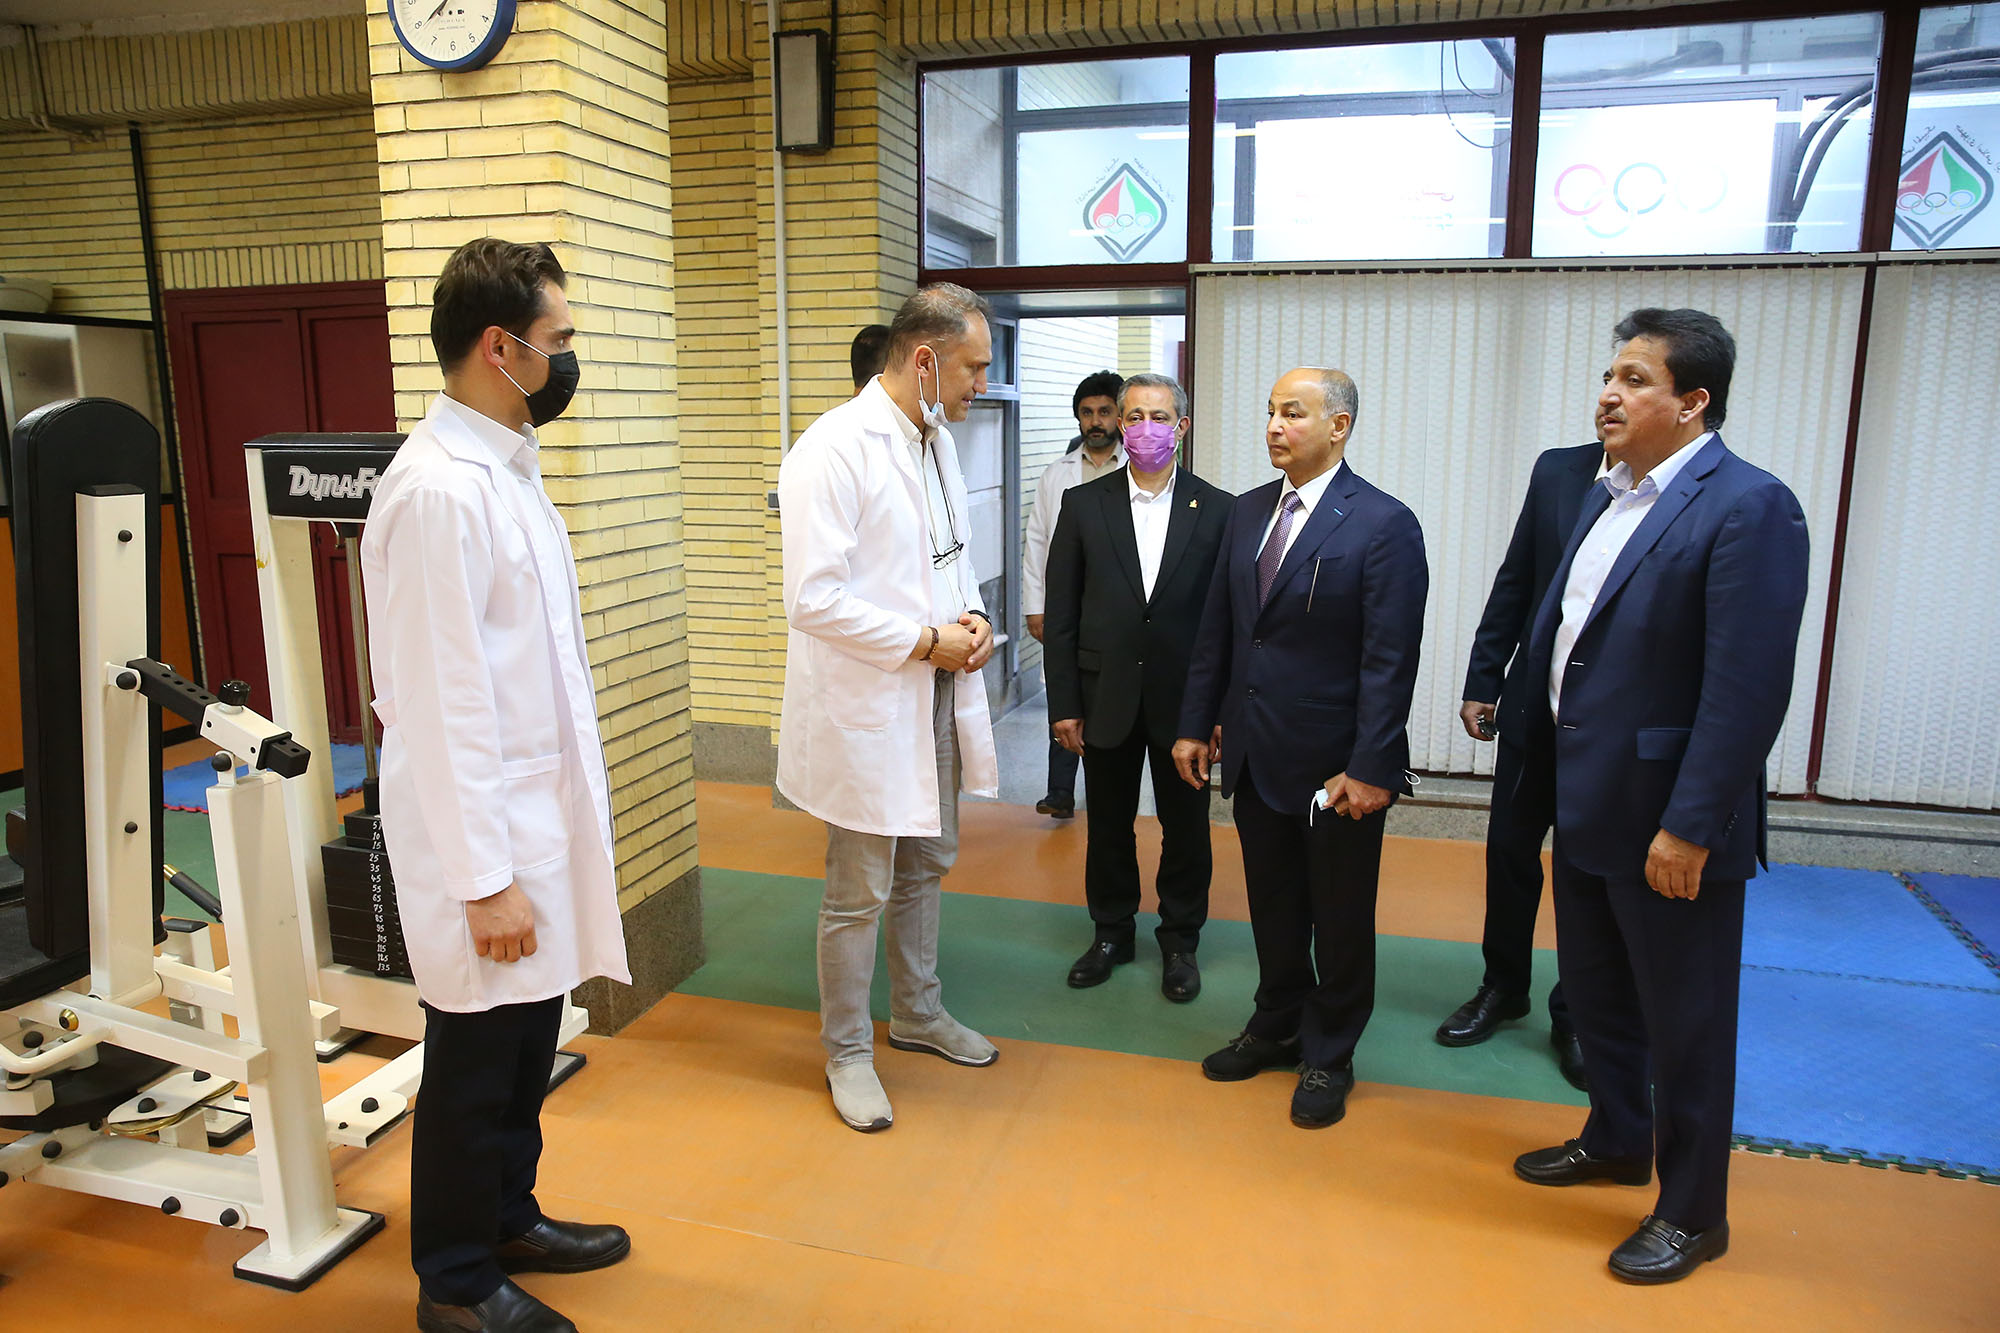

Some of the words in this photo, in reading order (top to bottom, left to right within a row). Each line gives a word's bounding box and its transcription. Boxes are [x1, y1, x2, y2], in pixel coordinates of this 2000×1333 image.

[481, 15, 489, 23] 4
[414, 20, 423, 30] 8
[430, 35, 438, 46] 7
[468, 32, 476, 43] 5
[449, 40, 456, 51] 6
[372, 831, 381, 840] 10
[372, 841, 382, 850] 15
[369, 852, 379, 863] 25
[369, 863, 380, 873] 35
[370, 874, 381, 883] 45
[372, 884, 382, 894] 55
[372, 893, 382, 903] 65
[373, 903, 383, 913] 75
[374, 914, 384, 923] 85
[376, 924, 385, 933] 95
[377, 963, 391, 971] 135
